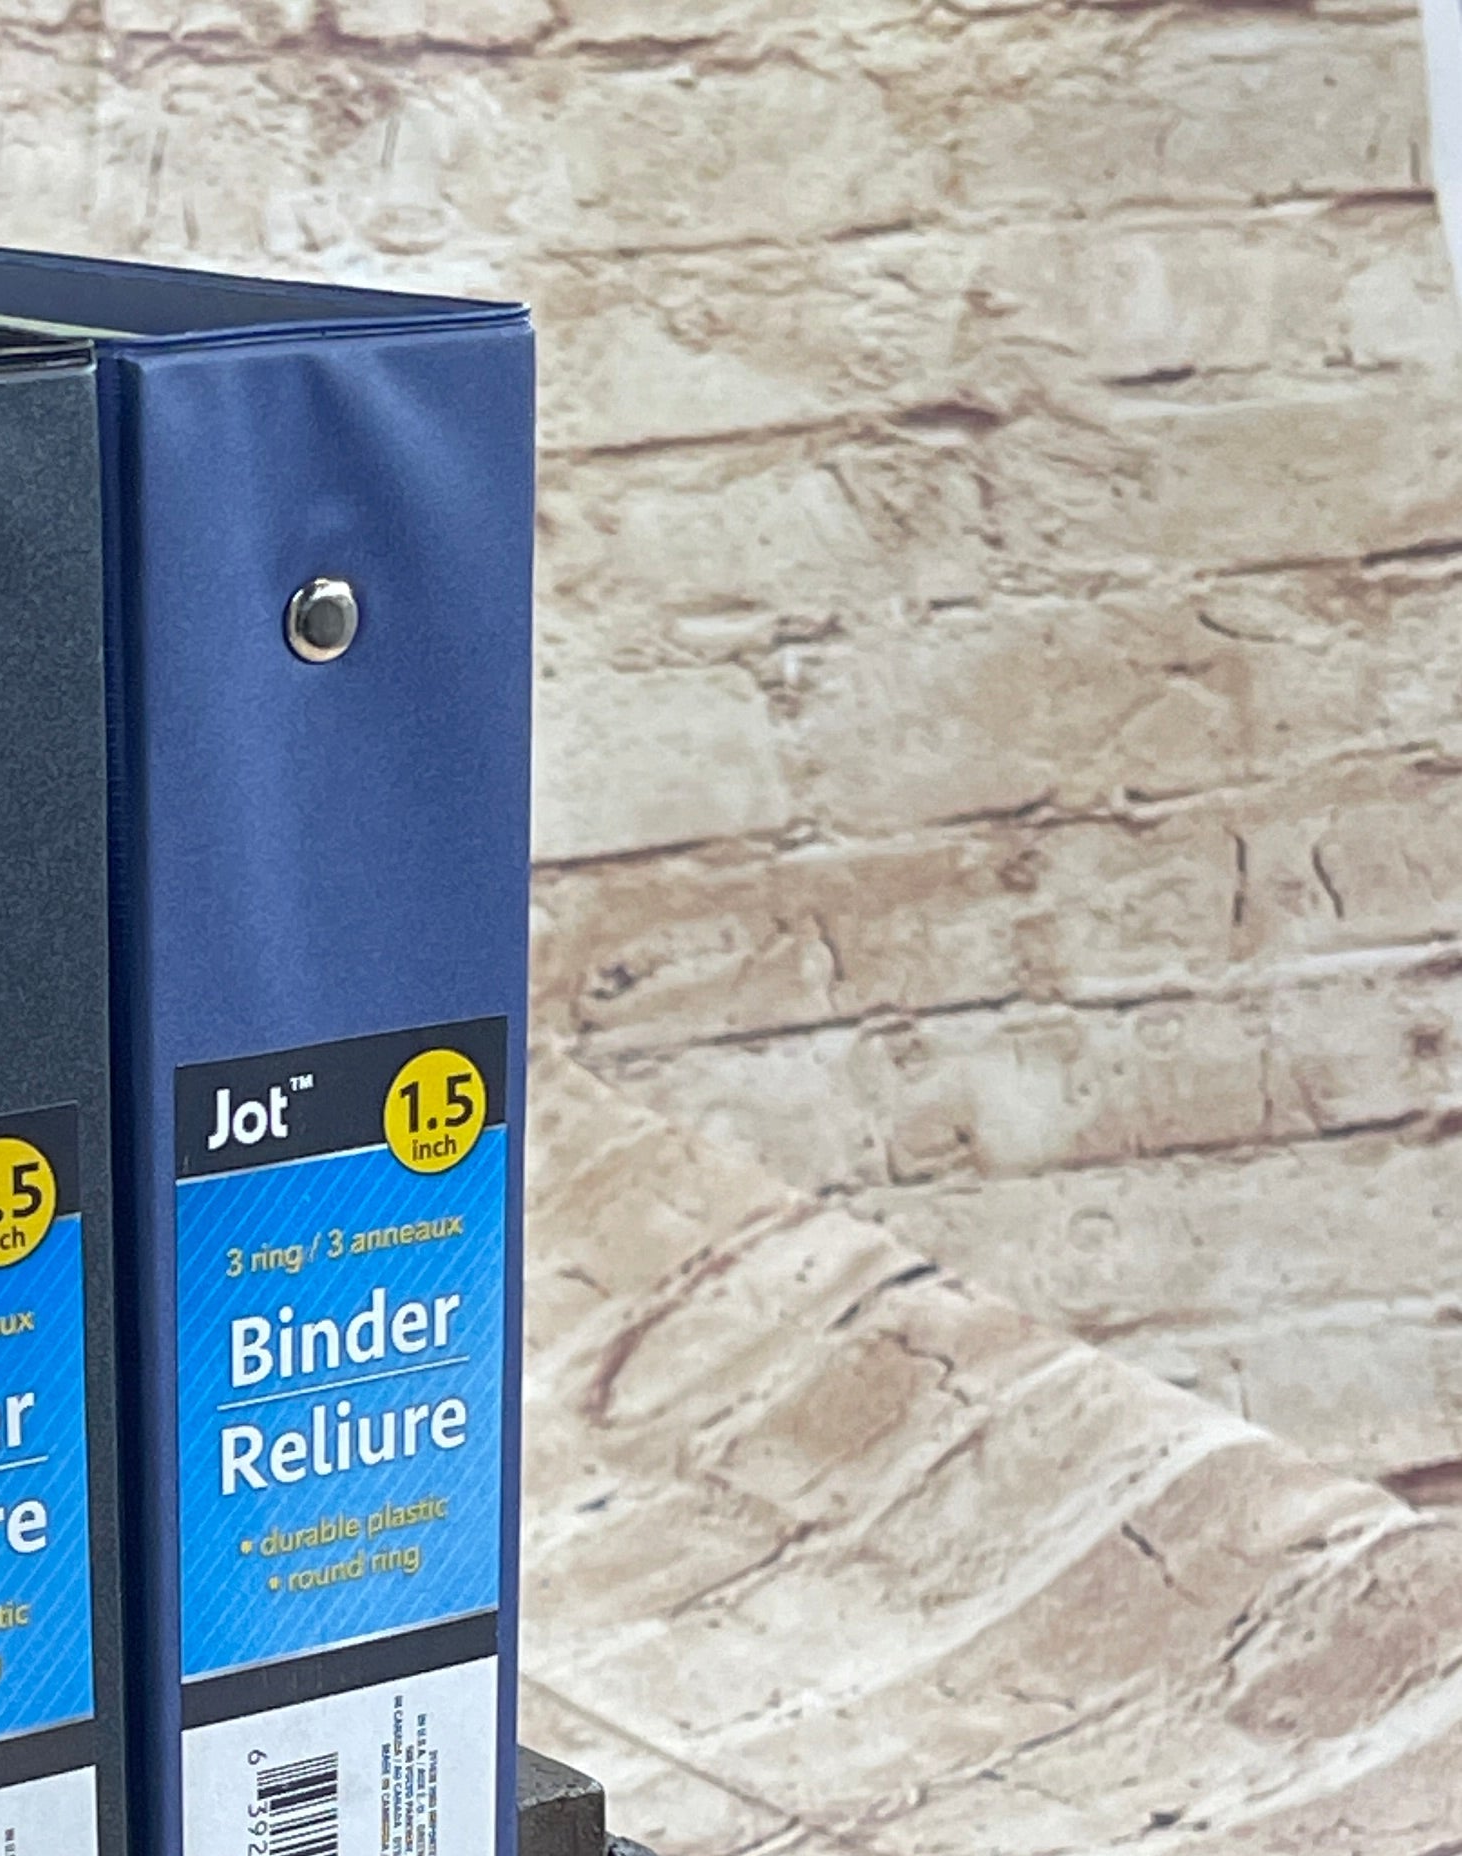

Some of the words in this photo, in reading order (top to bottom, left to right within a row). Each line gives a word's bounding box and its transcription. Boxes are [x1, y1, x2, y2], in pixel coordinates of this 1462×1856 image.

[399, 1072, 474, 1133] 1.5
[411, 1134, 457, 1162] inch
[225, 1248, 243, 1278] 3
[251, 1244, 303, 1276] ring
[309, 1231, 321, 1261] /
[327, 1229, 344, 1258] 3
[350, 1215, 464, 1254] anneaux
[231, 1287, 460, 1388] Binder
[220, 1398, 467, 1496] Reliure
[259, 1513, 360, 1557] durable
[367, 1495, 448, 1538] plastic
[287, 1553, 364, 1591] round
[371, 1543, 421, 1574] ring
[246, 1746, 267, 1766] 6
